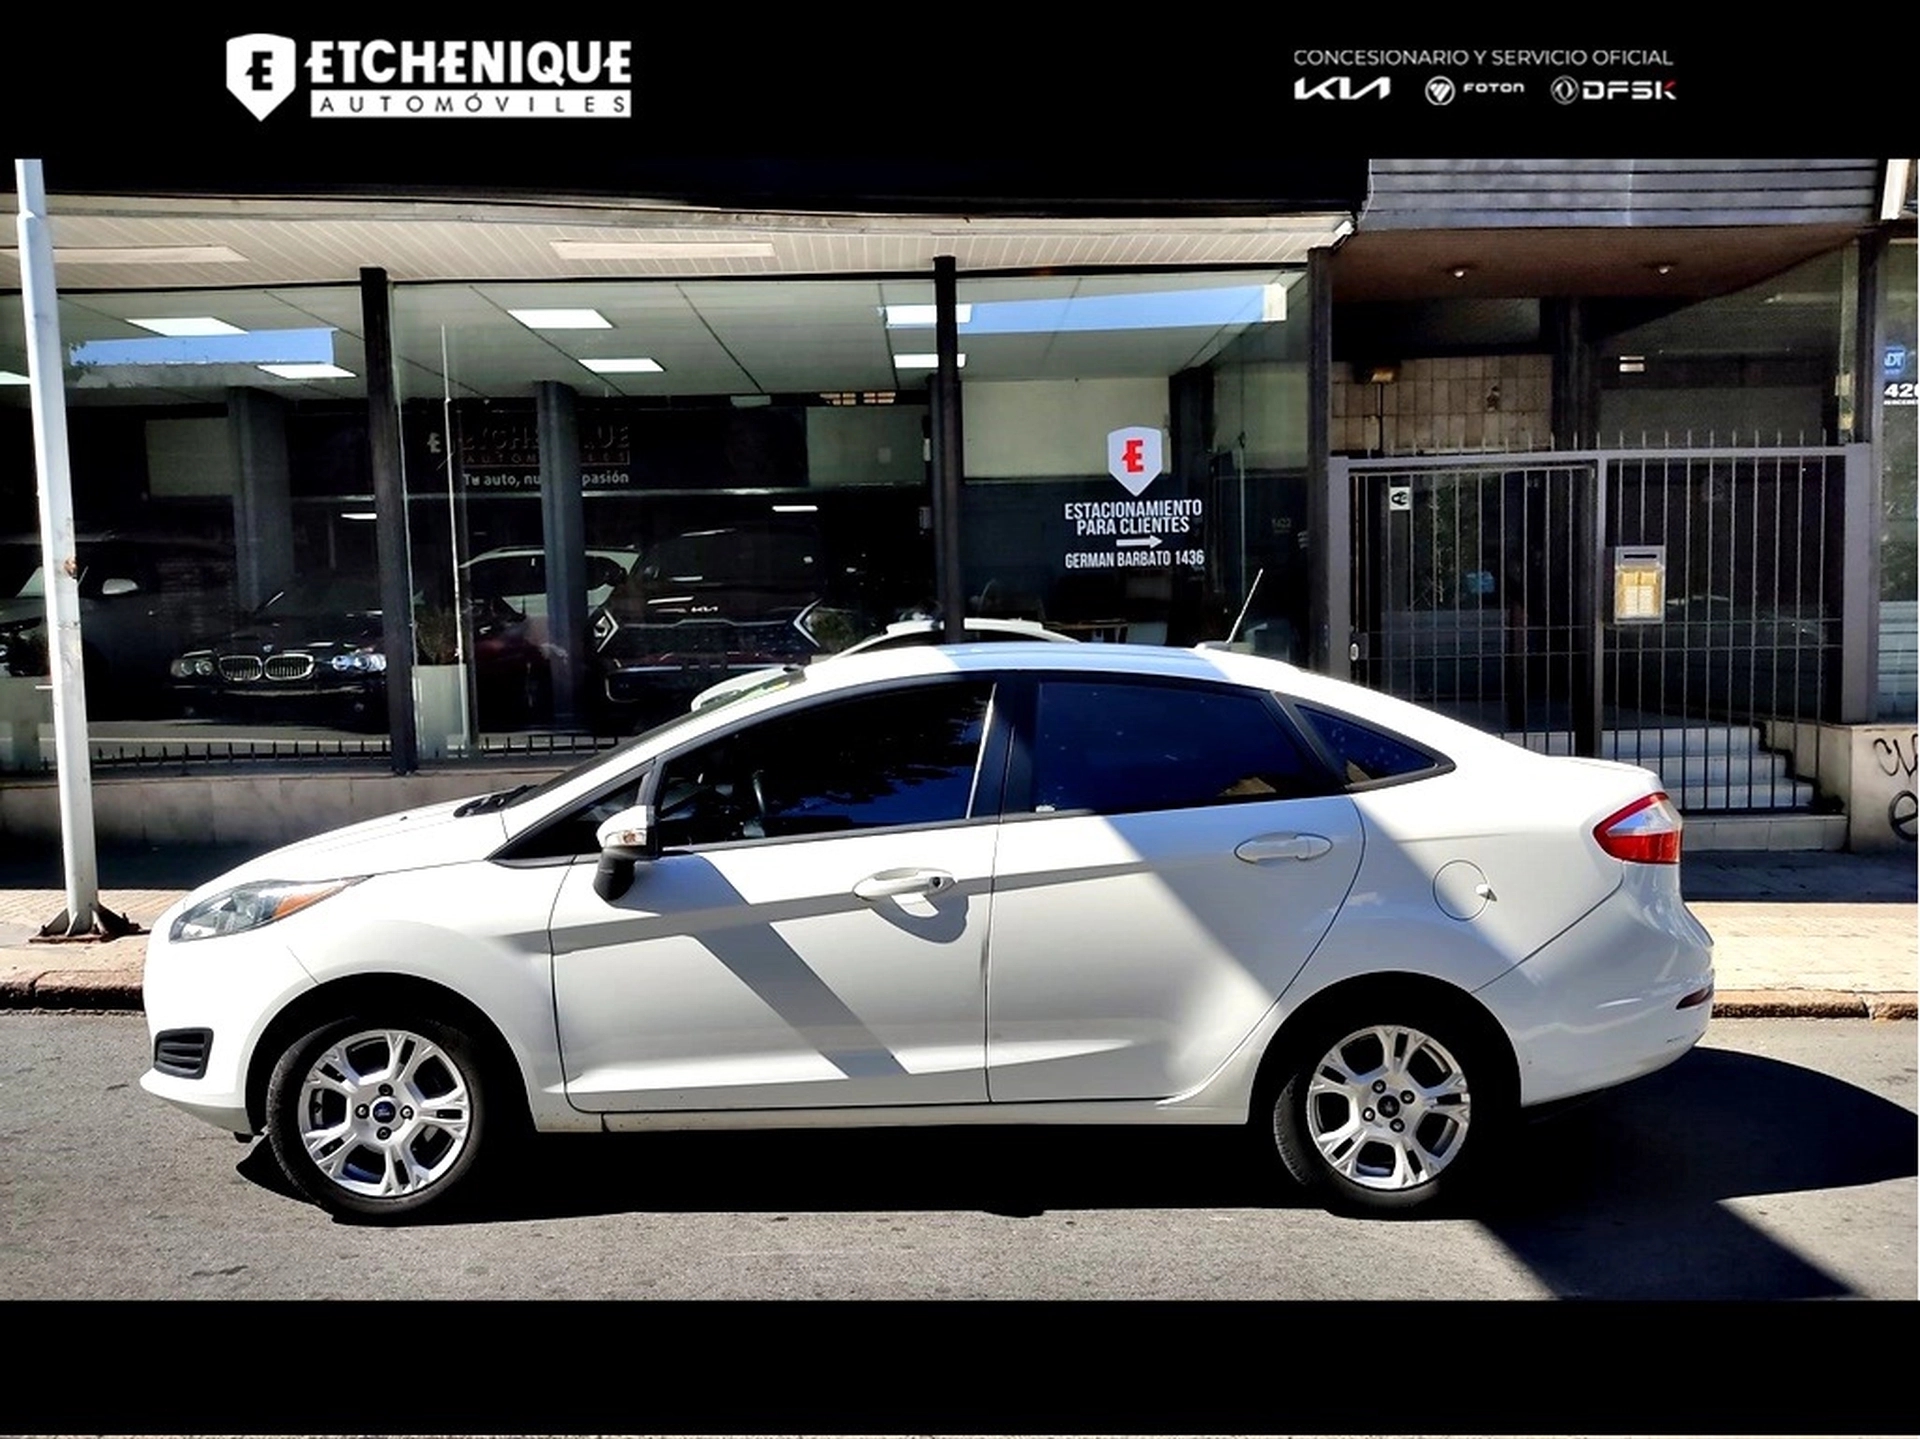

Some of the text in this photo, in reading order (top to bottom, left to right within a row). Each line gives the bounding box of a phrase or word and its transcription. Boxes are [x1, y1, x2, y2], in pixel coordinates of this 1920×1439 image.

[484, 474, 520, 488] auto,
[582, 471, 629, 486] pasión
[1064, 499, 1202, 520] ESTACIONAMIENTO
[1077, 516, 1190, 536] PARA CLIENTES
[1065, 549, 1205, 569] GERMAN BARBATO 1436
